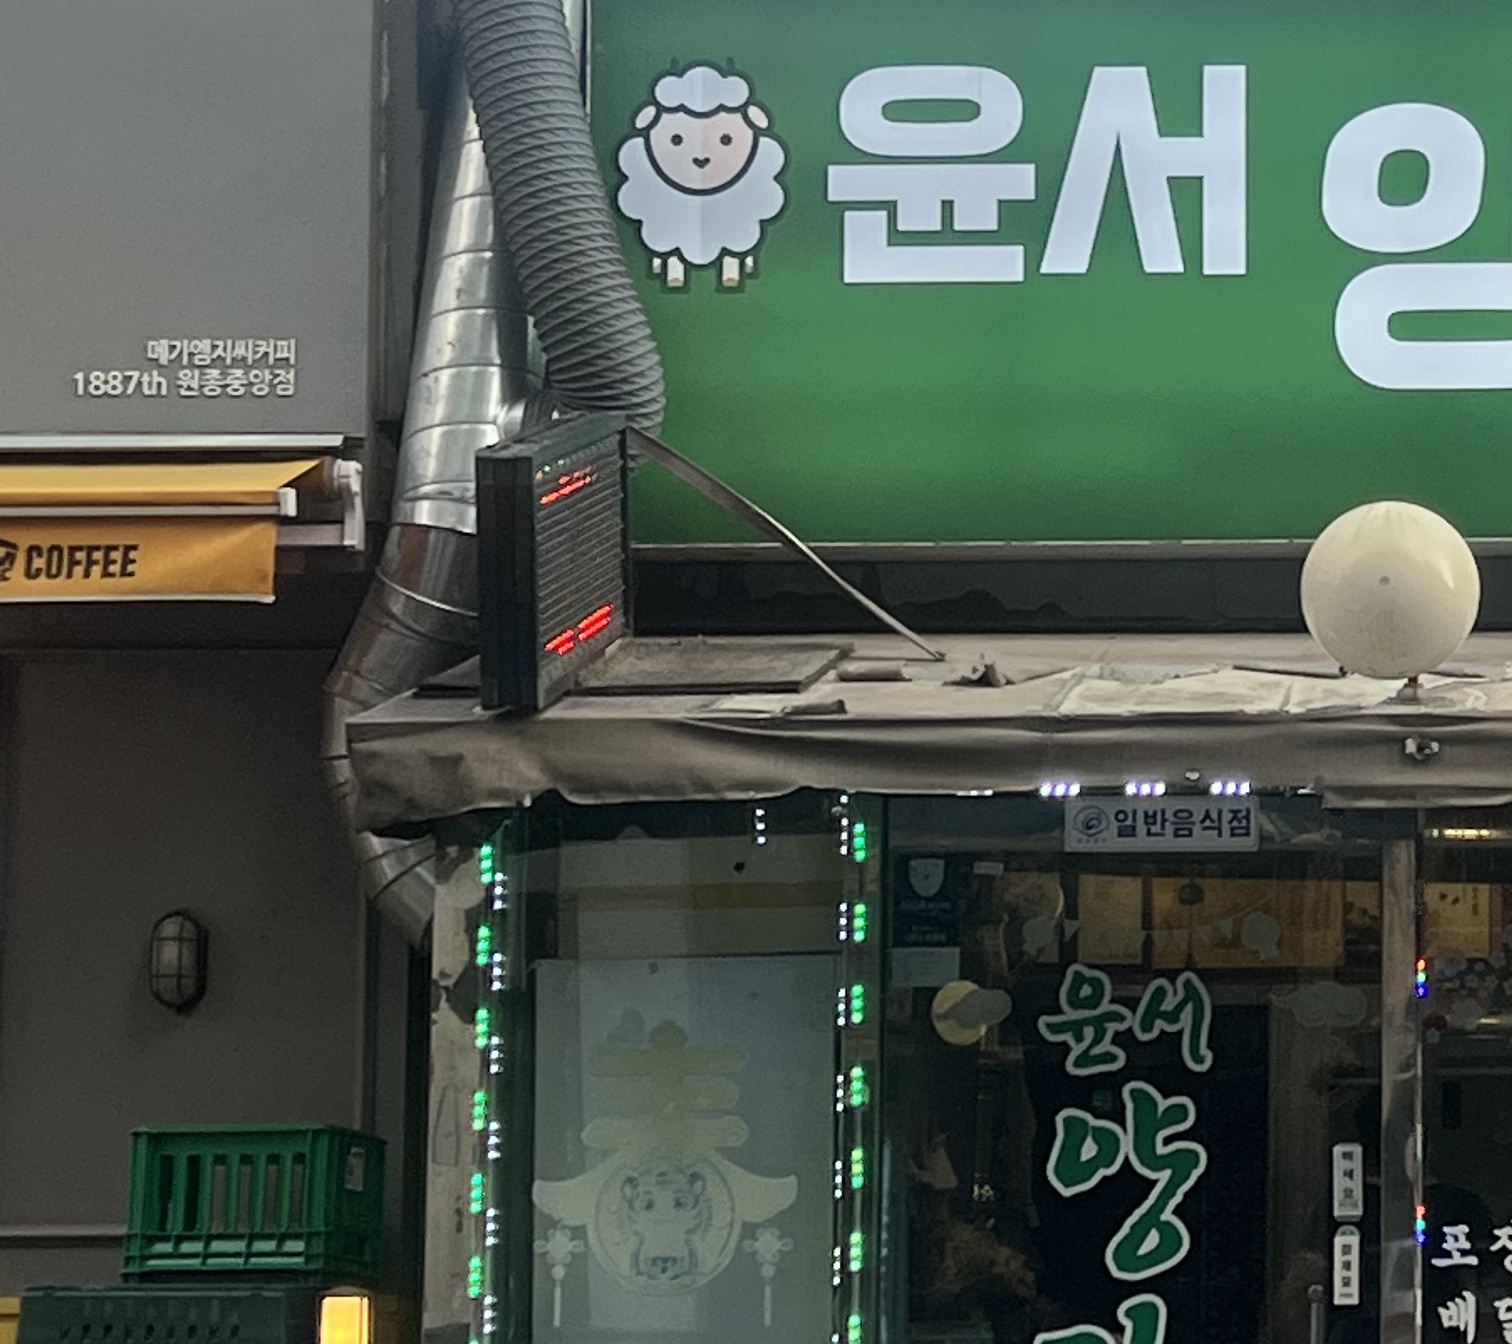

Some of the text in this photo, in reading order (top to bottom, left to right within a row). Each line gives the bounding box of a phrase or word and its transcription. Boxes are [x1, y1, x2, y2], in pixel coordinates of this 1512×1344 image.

[827, 64, 1247, 285] 윤서
[147, 338, 297, 366] 메가엠지씨커피
[72, 368, 296, 397] 1887th 원종중앙점
[23, 543, 140, 581] COFFEE
[1113, 807, 1252, 839] 일반음식점
[1038, 963, 1213, 1076] 윤서
